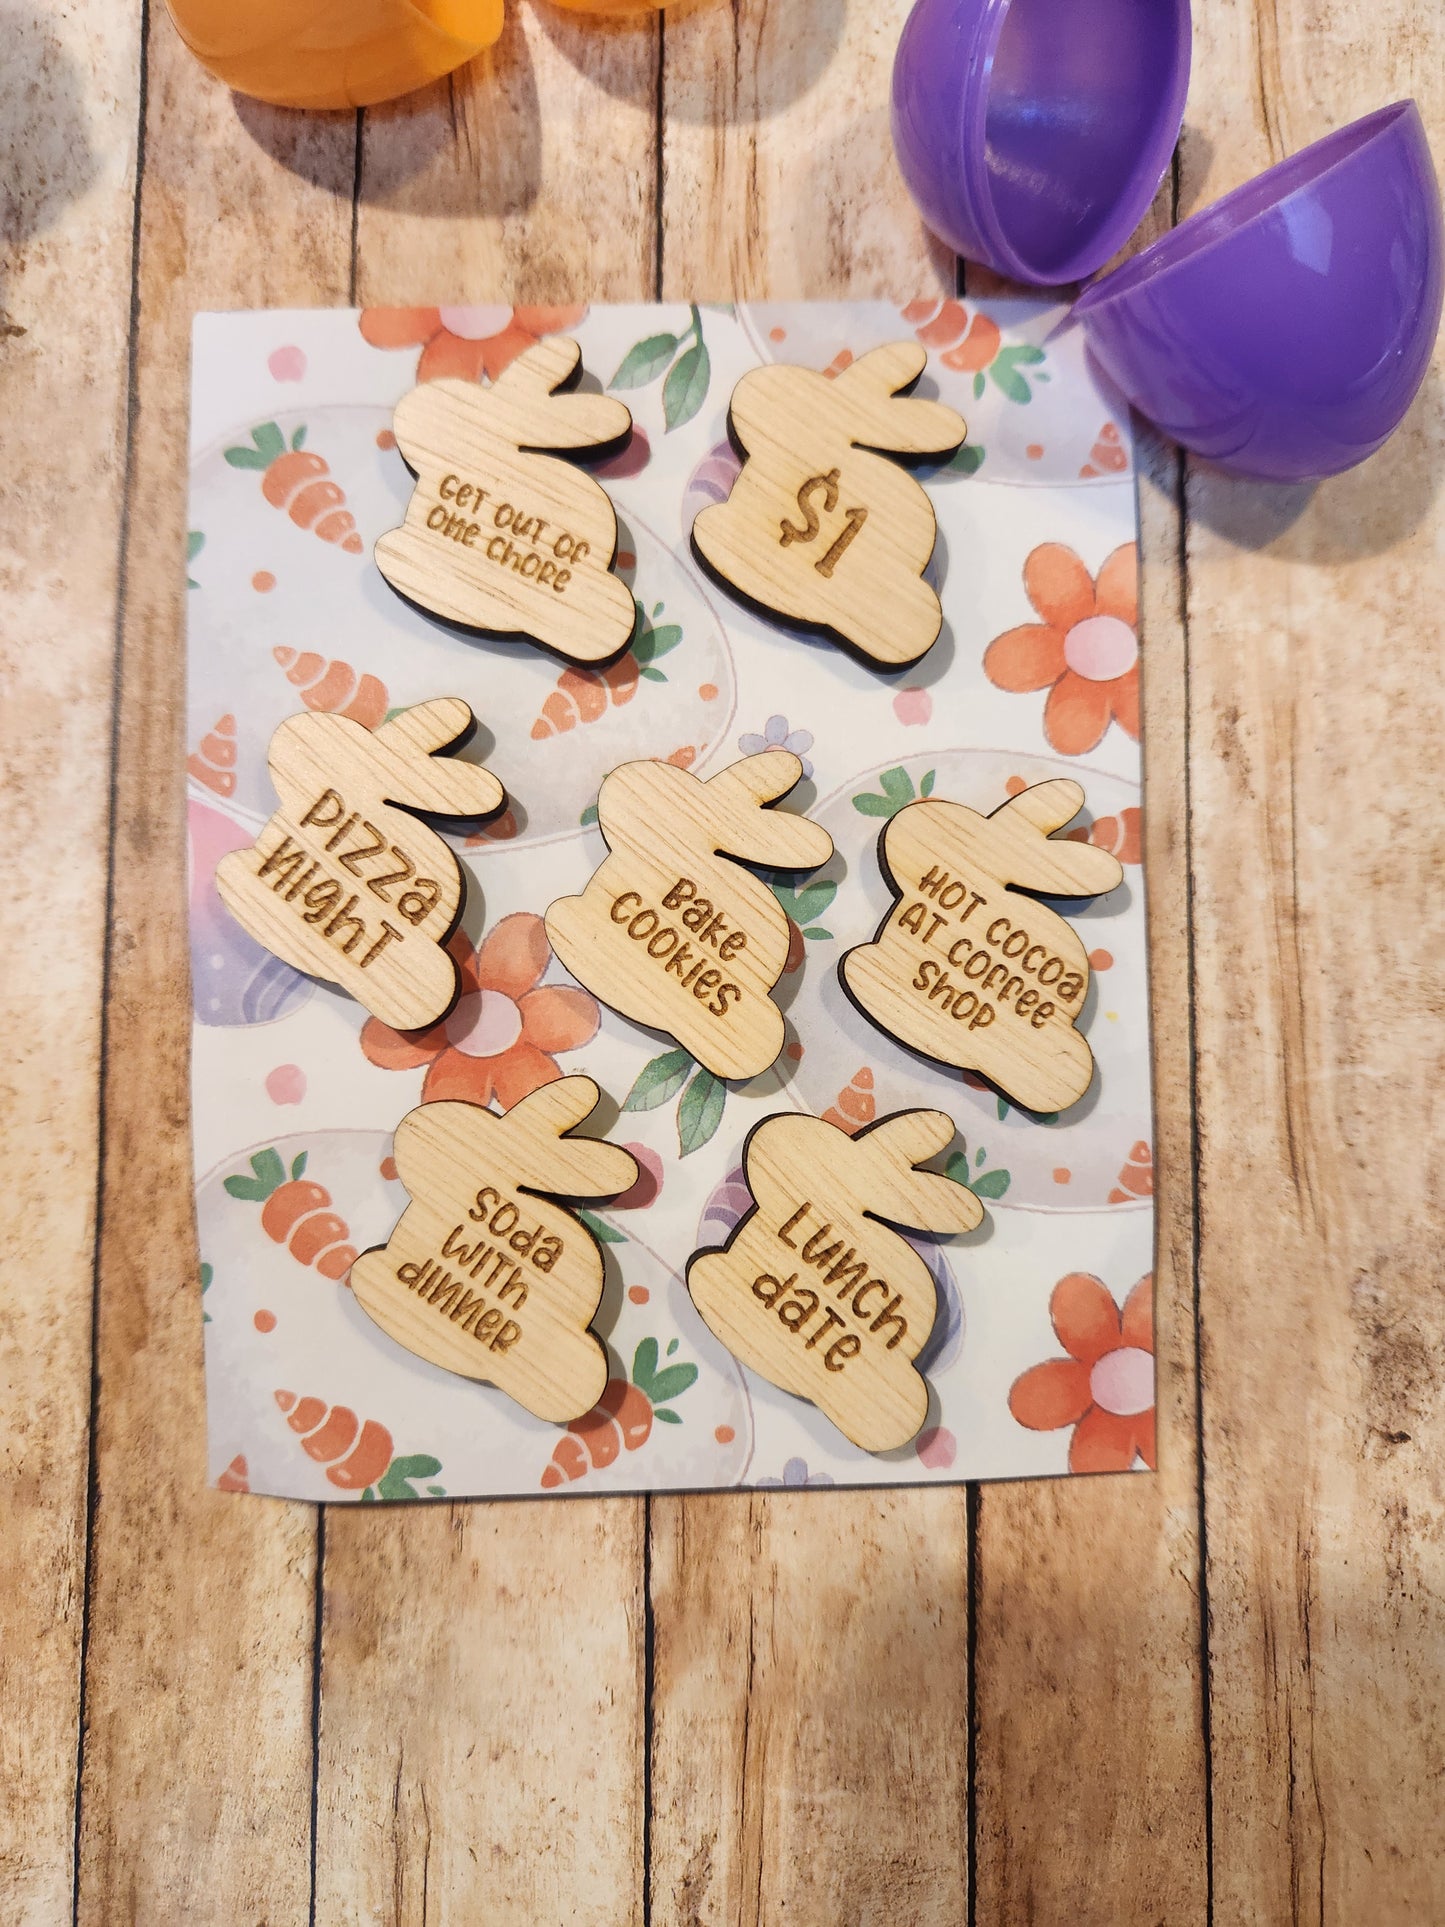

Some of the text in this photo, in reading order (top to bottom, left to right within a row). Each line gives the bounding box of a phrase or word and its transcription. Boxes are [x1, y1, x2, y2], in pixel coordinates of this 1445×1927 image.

[779, 468, 868, 579] $1
[661, 877, 748, 961] Bake
[898, 902, 948, 943] AT
[918, 865, 988, 923] HOT
